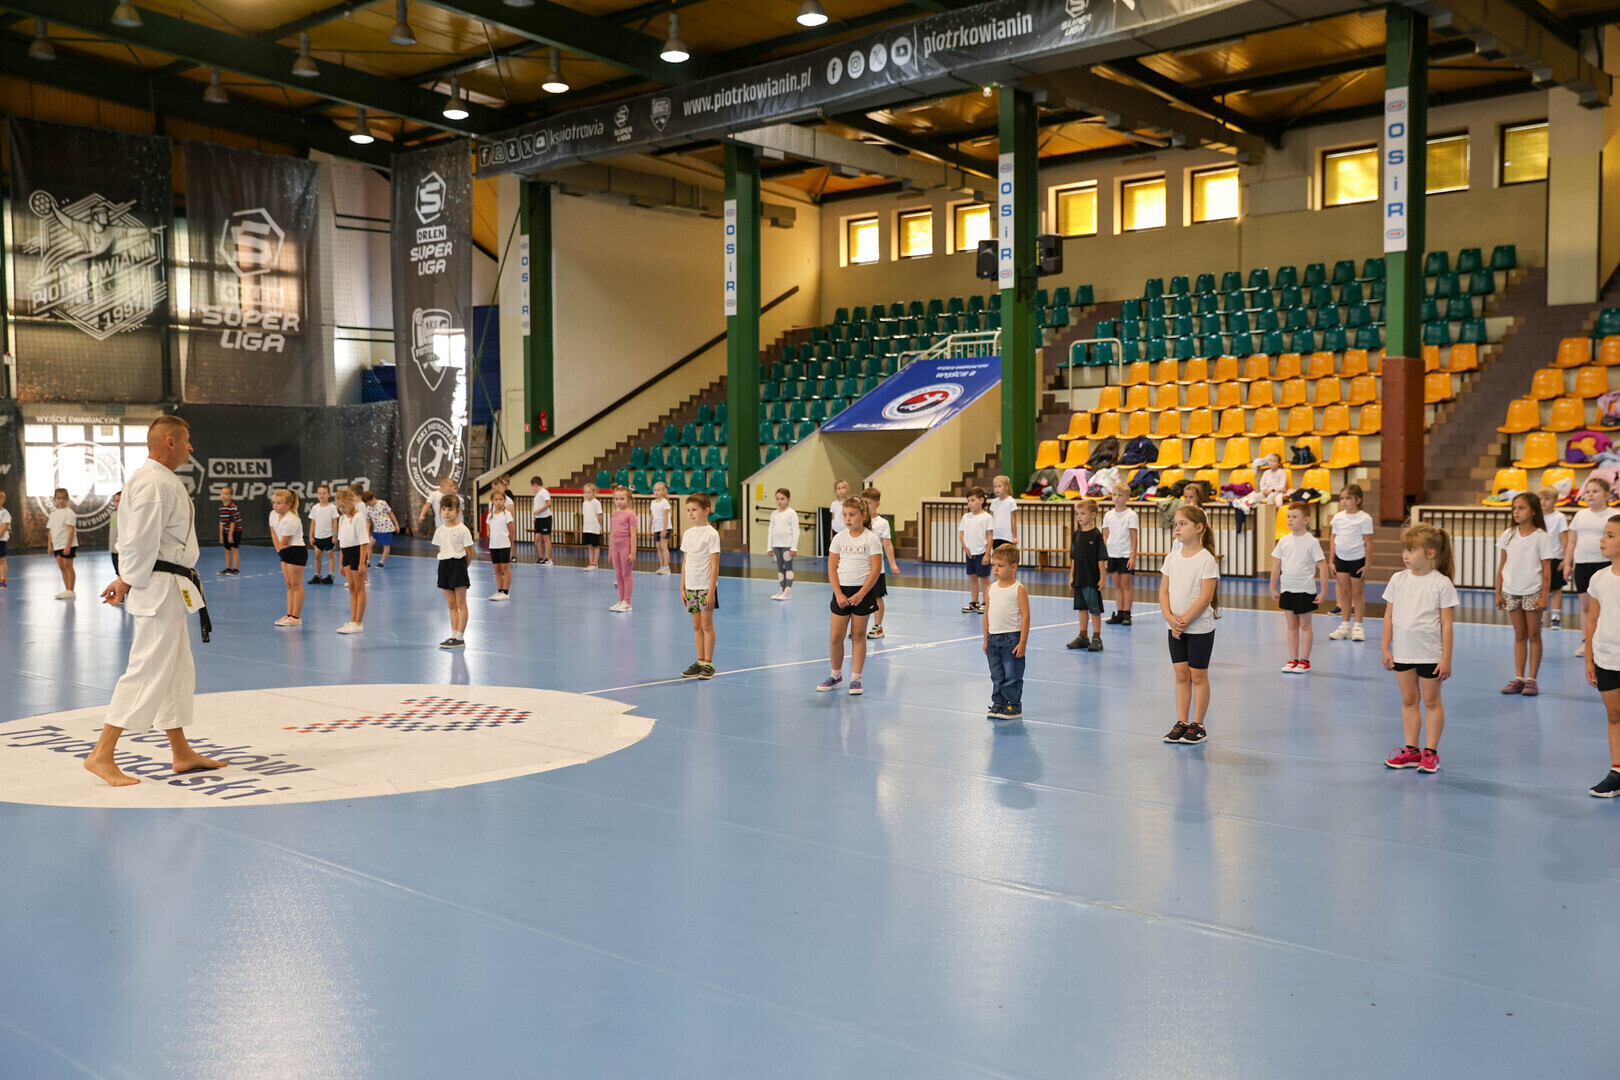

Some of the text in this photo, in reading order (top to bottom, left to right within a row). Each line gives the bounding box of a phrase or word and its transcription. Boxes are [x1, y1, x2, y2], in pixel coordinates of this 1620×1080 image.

[1061, 13, 1092, 31] SUPER
[923, 12, 1032, 58] piotrkowianin
[683, 66, 812, 117] www.piotrkowianin.pl
[614, 126, 633, 137] SUPER
[418, 227, 445, 241] ORLEN
[410, 241, 453, 262] SUPER
[32, 239, 156, 308] PIOTRKOWIANIN
[418, 258, 446, 276] LIGA
[102, 294, 143, 329] 1997
[201, 304, 300, 332] SUPER
[220, 329, 286, 353] LIGA
[35, 414, 121, 425] WYJŚCIE EWAKUACYJNE
[212, 461, 268, 475] ORLEN
[840, 545, 866, 554] GUCCI
